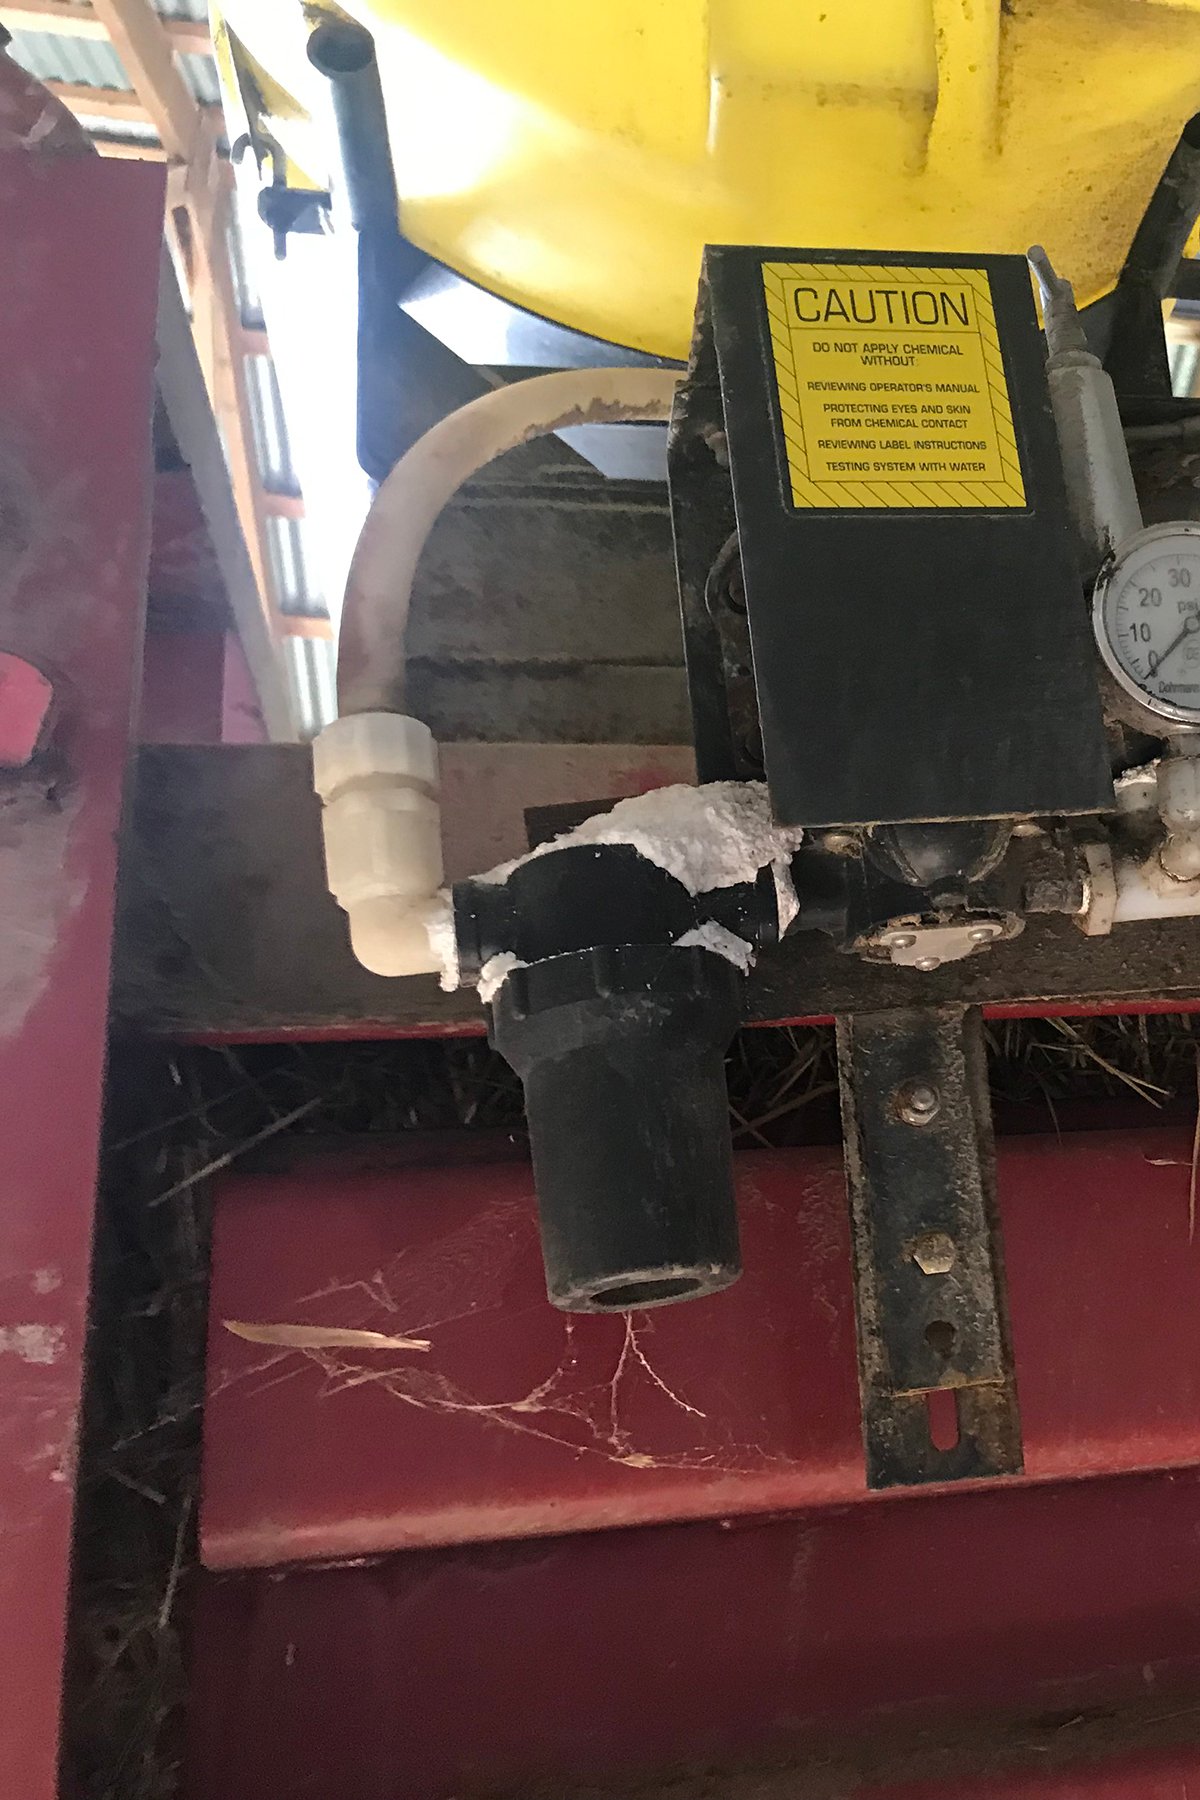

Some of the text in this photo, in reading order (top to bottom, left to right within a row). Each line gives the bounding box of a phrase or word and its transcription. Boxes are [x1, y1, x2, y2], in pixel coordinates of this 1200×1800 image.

[793, 287, 969, 326] CAUTION
[813, 342, 964, 356] DO NOT APPLY CHEMICAL
[807, 381, 980, 394] REVIEWING OPERATOR'S MANUAL
[823, 403, 971, 414] PROTECTING EYES AND SKIN
[831, 418, 968, 429] FROM CHEMICAL CONTACT
[817, 440, 987, 450] REVIEWING LABEL INSTRUCTIONS
[826, 462, 986, 471] TESTING SYSTEM WITH WATER
[1168, 568, 1191, 588] 30
[1138, 587, 1162, 608] 20
[1177, 598, 1199, 614] psi
[1129, 622, 1151, 642] 10
